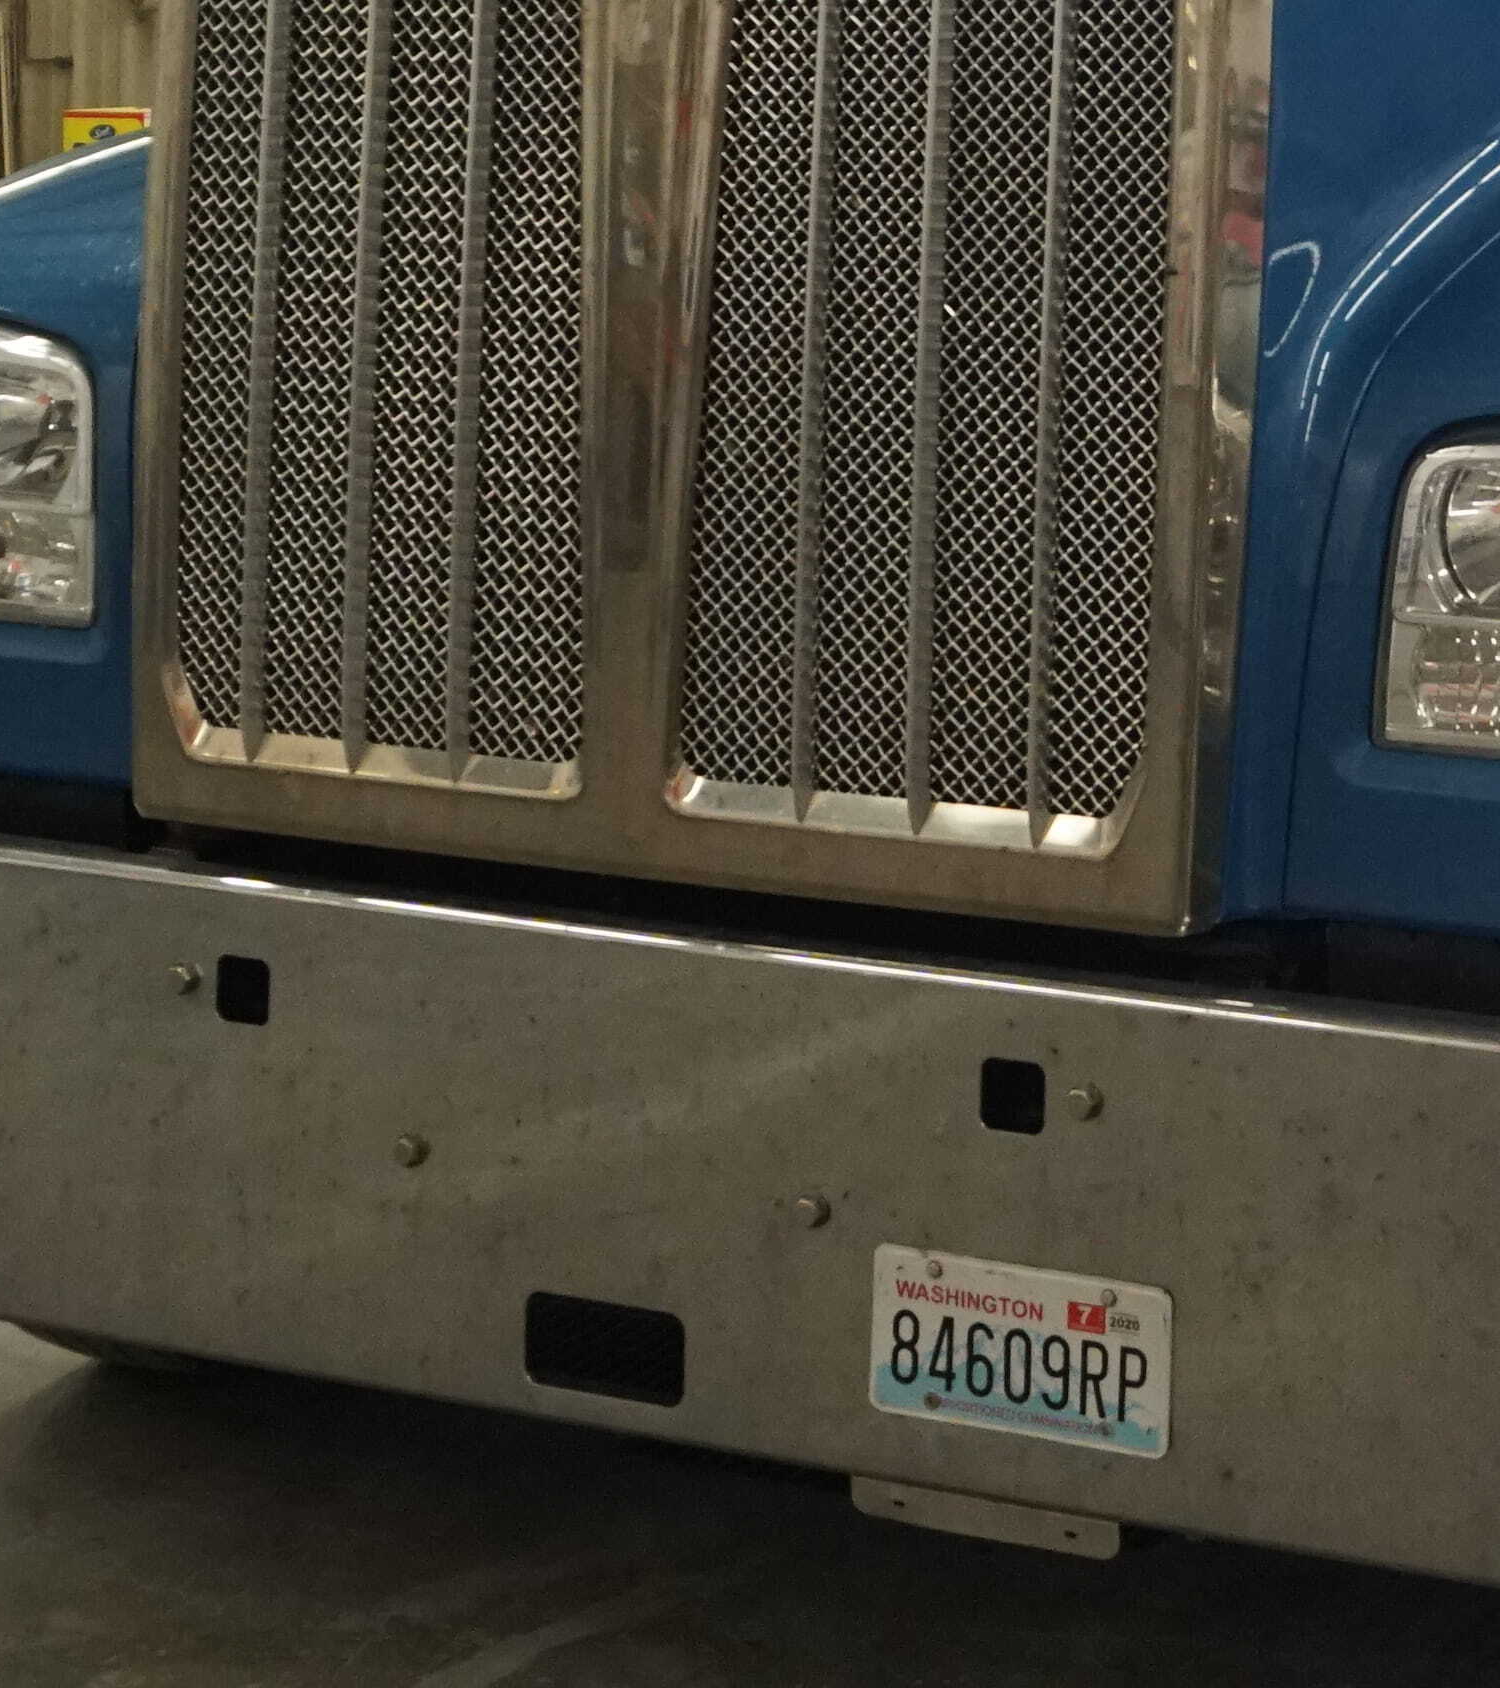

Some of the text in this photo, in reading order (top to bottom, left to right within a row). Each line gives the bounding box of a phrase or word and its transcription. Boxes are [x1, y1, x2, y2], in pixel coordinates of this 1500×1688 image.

[895, 1279, 1045, 1322] WASHINGTON
[1076, 1304, 1092, 1326] 7
[1109, 1315, 1141, 1332] 2020
[890, 1308, 1148, 1422] 84609RP
